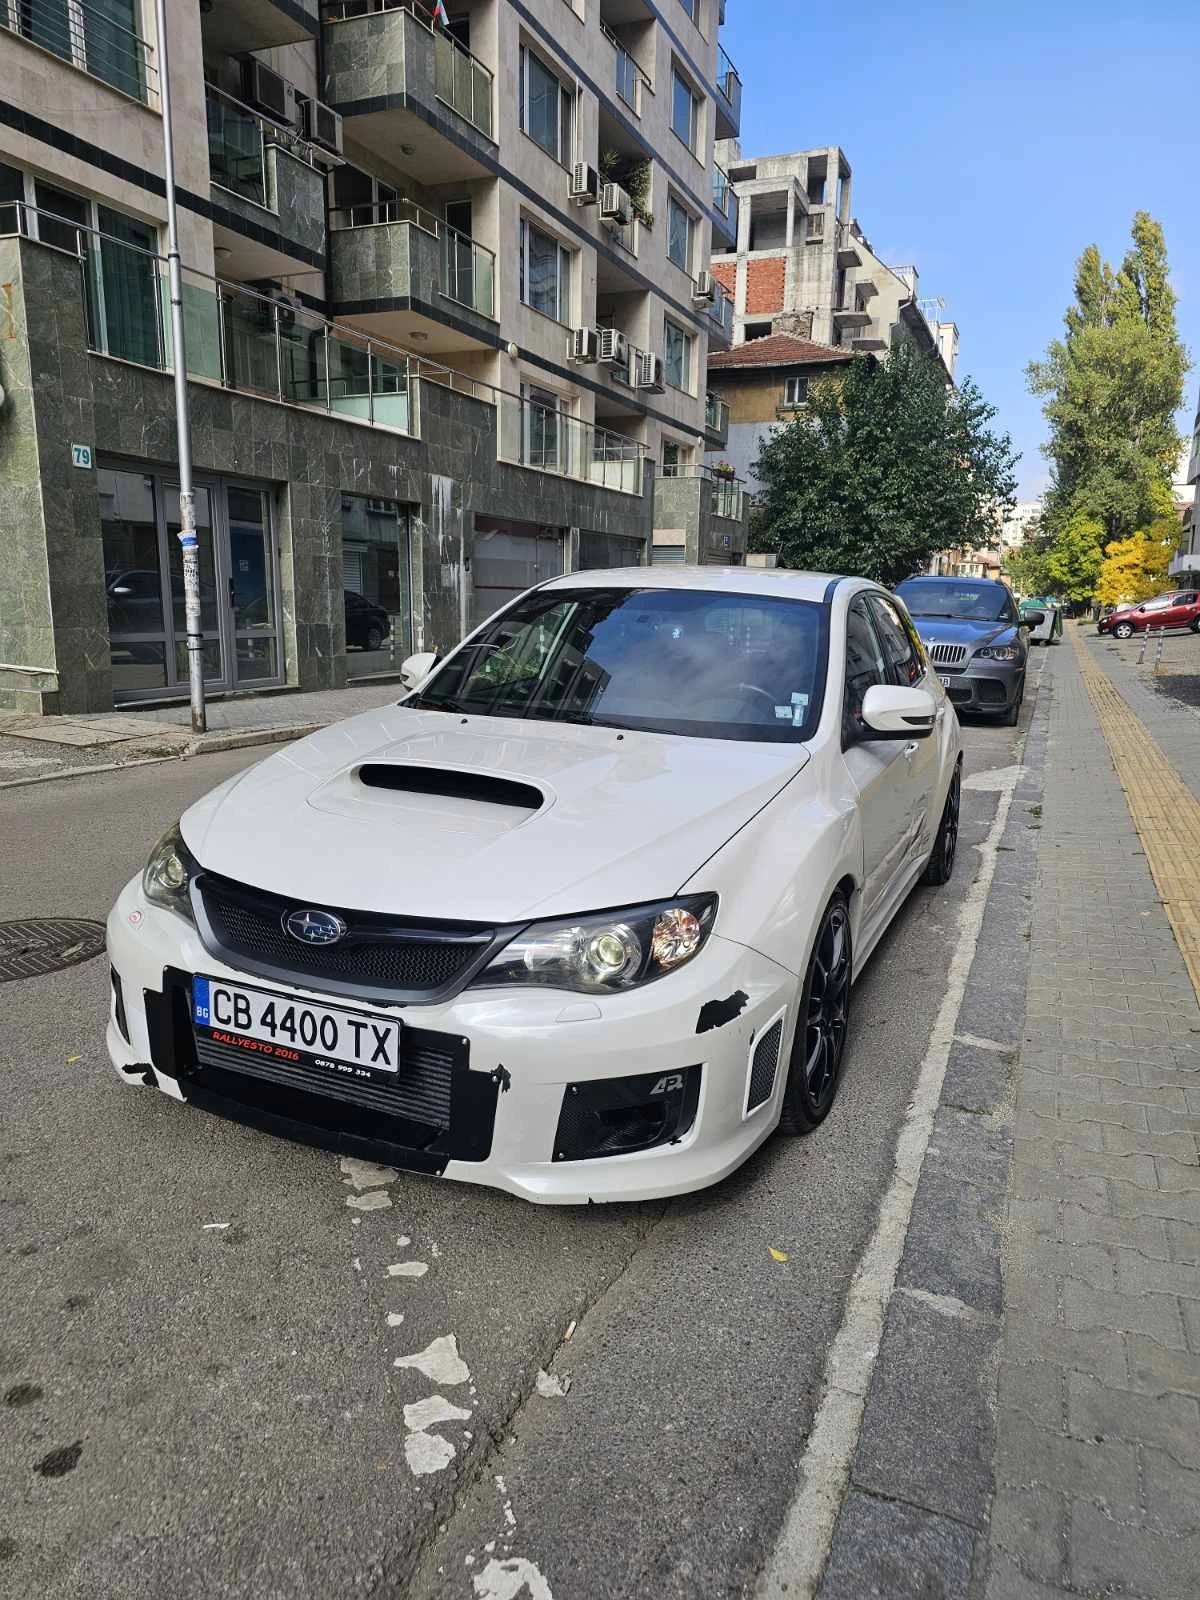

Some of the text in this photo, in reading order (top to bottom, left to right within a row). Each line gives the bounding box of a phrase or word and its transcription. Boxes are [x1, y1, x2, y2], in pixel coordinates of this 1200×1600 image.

[74, 447, 90, 464] 79
[196, 1005, 209, 1018] BG
[213, 988, 391, 1066] CB 4400 TX
[212, 1031, 300, 1061] RALLYESTO 2016
